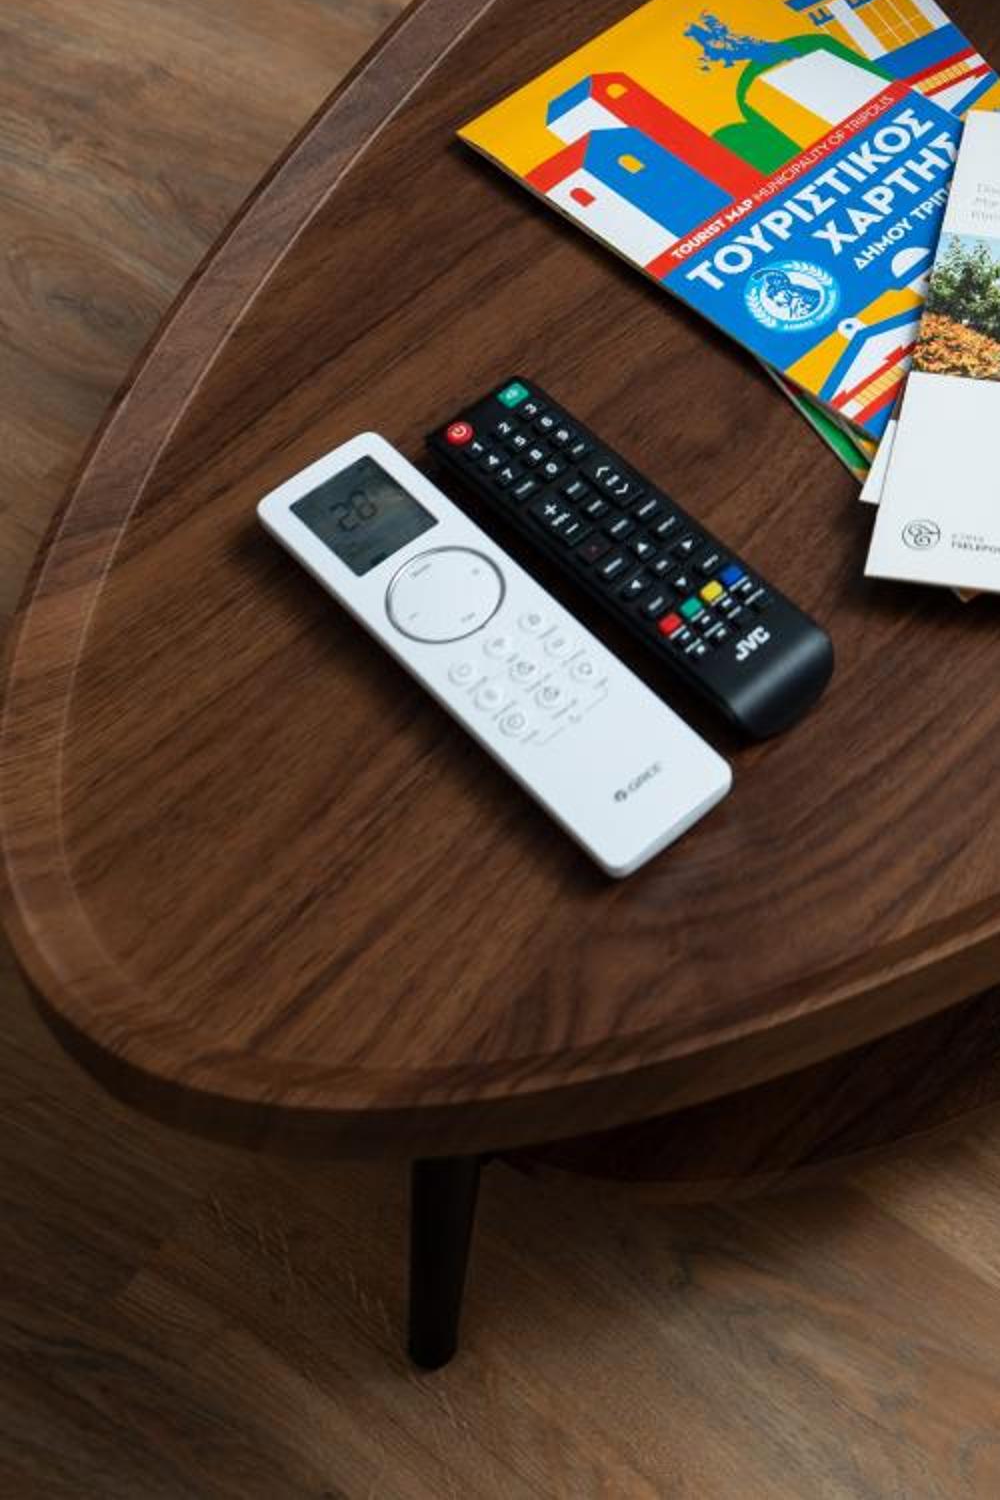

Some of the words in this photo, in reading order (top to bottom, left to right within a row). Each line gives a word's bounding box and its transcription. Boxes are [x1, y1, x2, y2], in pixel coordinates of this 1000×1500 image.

[671, 217, 726, 260] TOURIST
[725, 197, 754, 223] MAP
[753, 143, 830, 201] MUNICIPALITY
[826, 127, 847, 149] OF
[844, 93, 896, 133] TRIPOLIS
[685, 107, 935, 291] ΤΟΥΡΙΣΤΙΚΟΣ
[811, 131, 957, 255] ΧΑΡΤΗΣ
[853, 217, 913, 270] ΔΗΜΟΥ
[910, 183, 952, 220] ΤΡΙΠ
[524, 403, 538, 415] 3
[498, 421, 511, 434] 2
[540, 416, 553, 428] 6
[471, 441, 484, 452] 1
[514, 435, 527, 447] 5
[488, 454, 500, 466] 4
[529, 448, 543, 461] 8
[501, 467, 514, 480] 7
[735, 625, 771, 662] JVC
